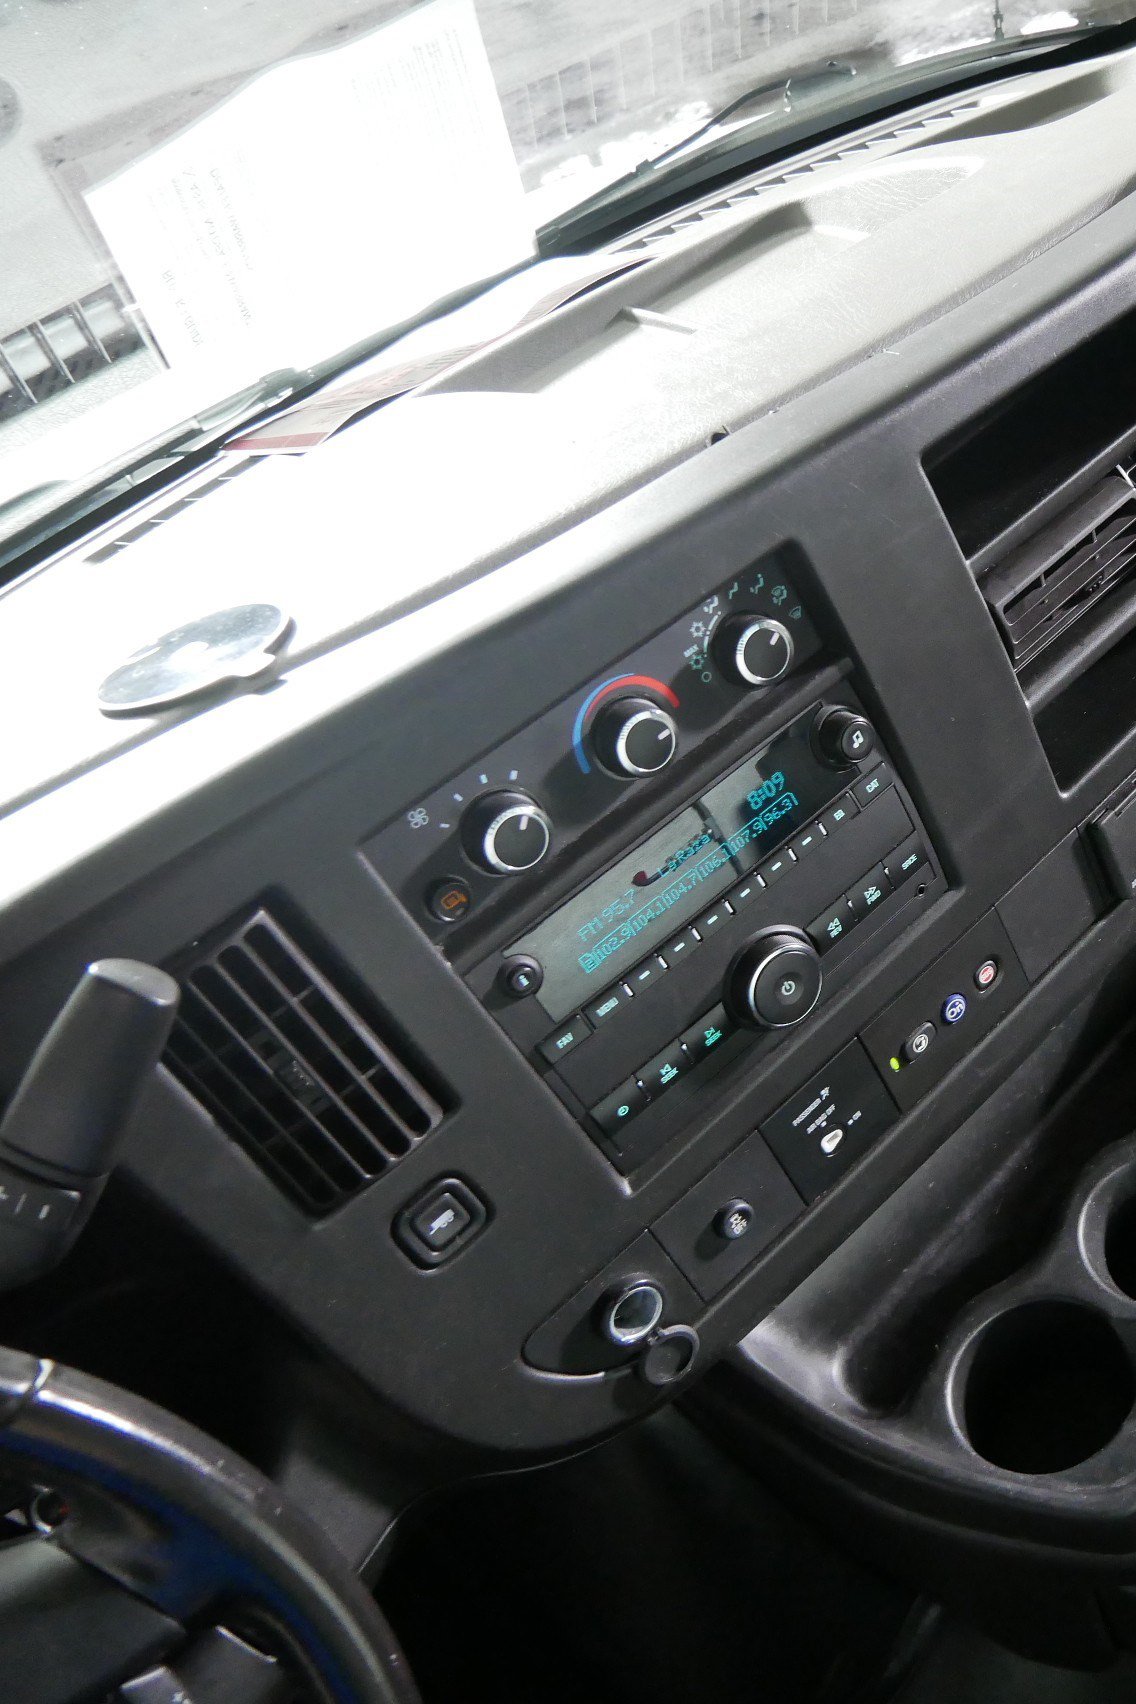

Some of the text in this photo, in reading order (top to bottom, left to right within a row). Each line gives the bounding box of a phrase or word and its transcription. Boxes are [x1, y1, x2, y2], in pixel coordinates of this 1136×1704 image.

[746, 771, 786, 811] 8:09
[865, 778, 880, 793] CAT
[577, 889, 636, 942] FM 95.7
[556, 1032, 575, 1050] FAV
[660, 1067, 679, 1084] SEEK
